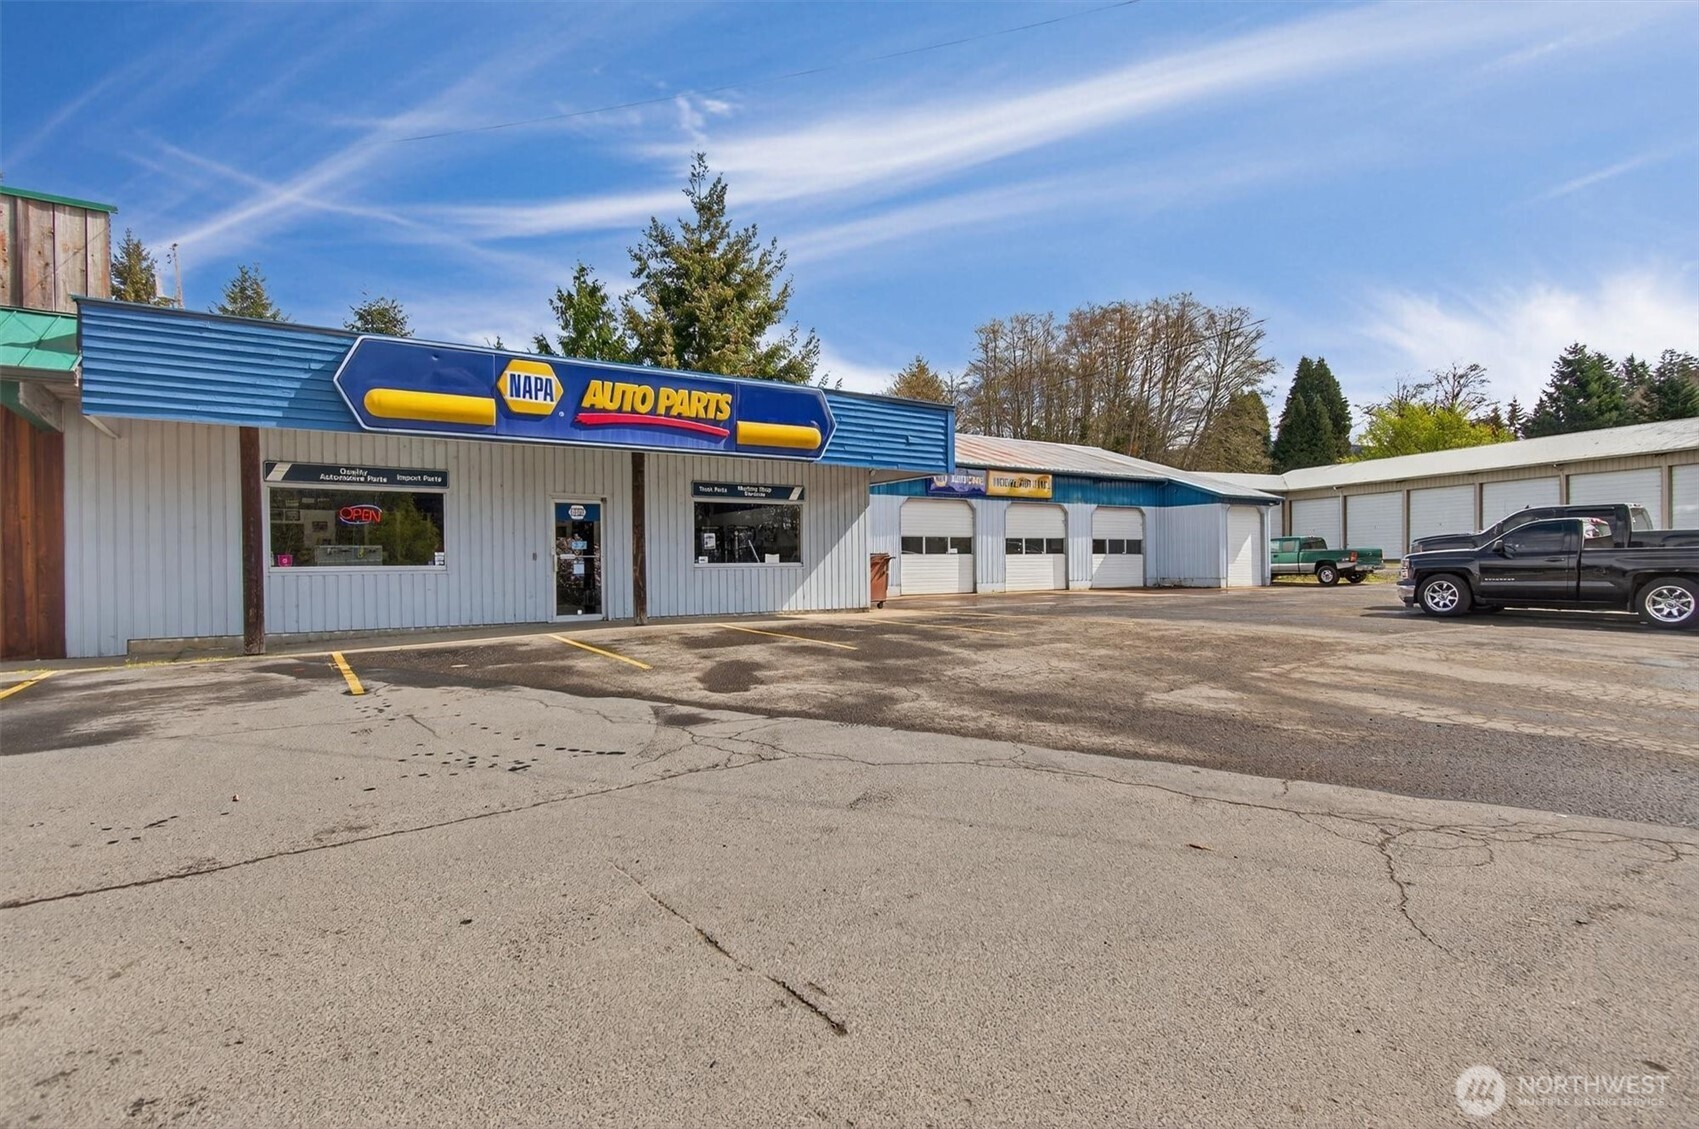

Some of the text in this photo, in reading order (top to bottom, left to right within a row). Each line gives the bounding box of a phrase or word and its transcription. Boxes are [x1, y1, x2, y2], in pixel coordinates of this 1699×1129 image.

[509, 373, 554, 403] NAPA
[581, 380, 732, 421] AUTO PARTS
[367, 475, 388, 483] Parts
[396, 473, 442, 483] Import Parts
[339, 507, 382, 523] OPEN
